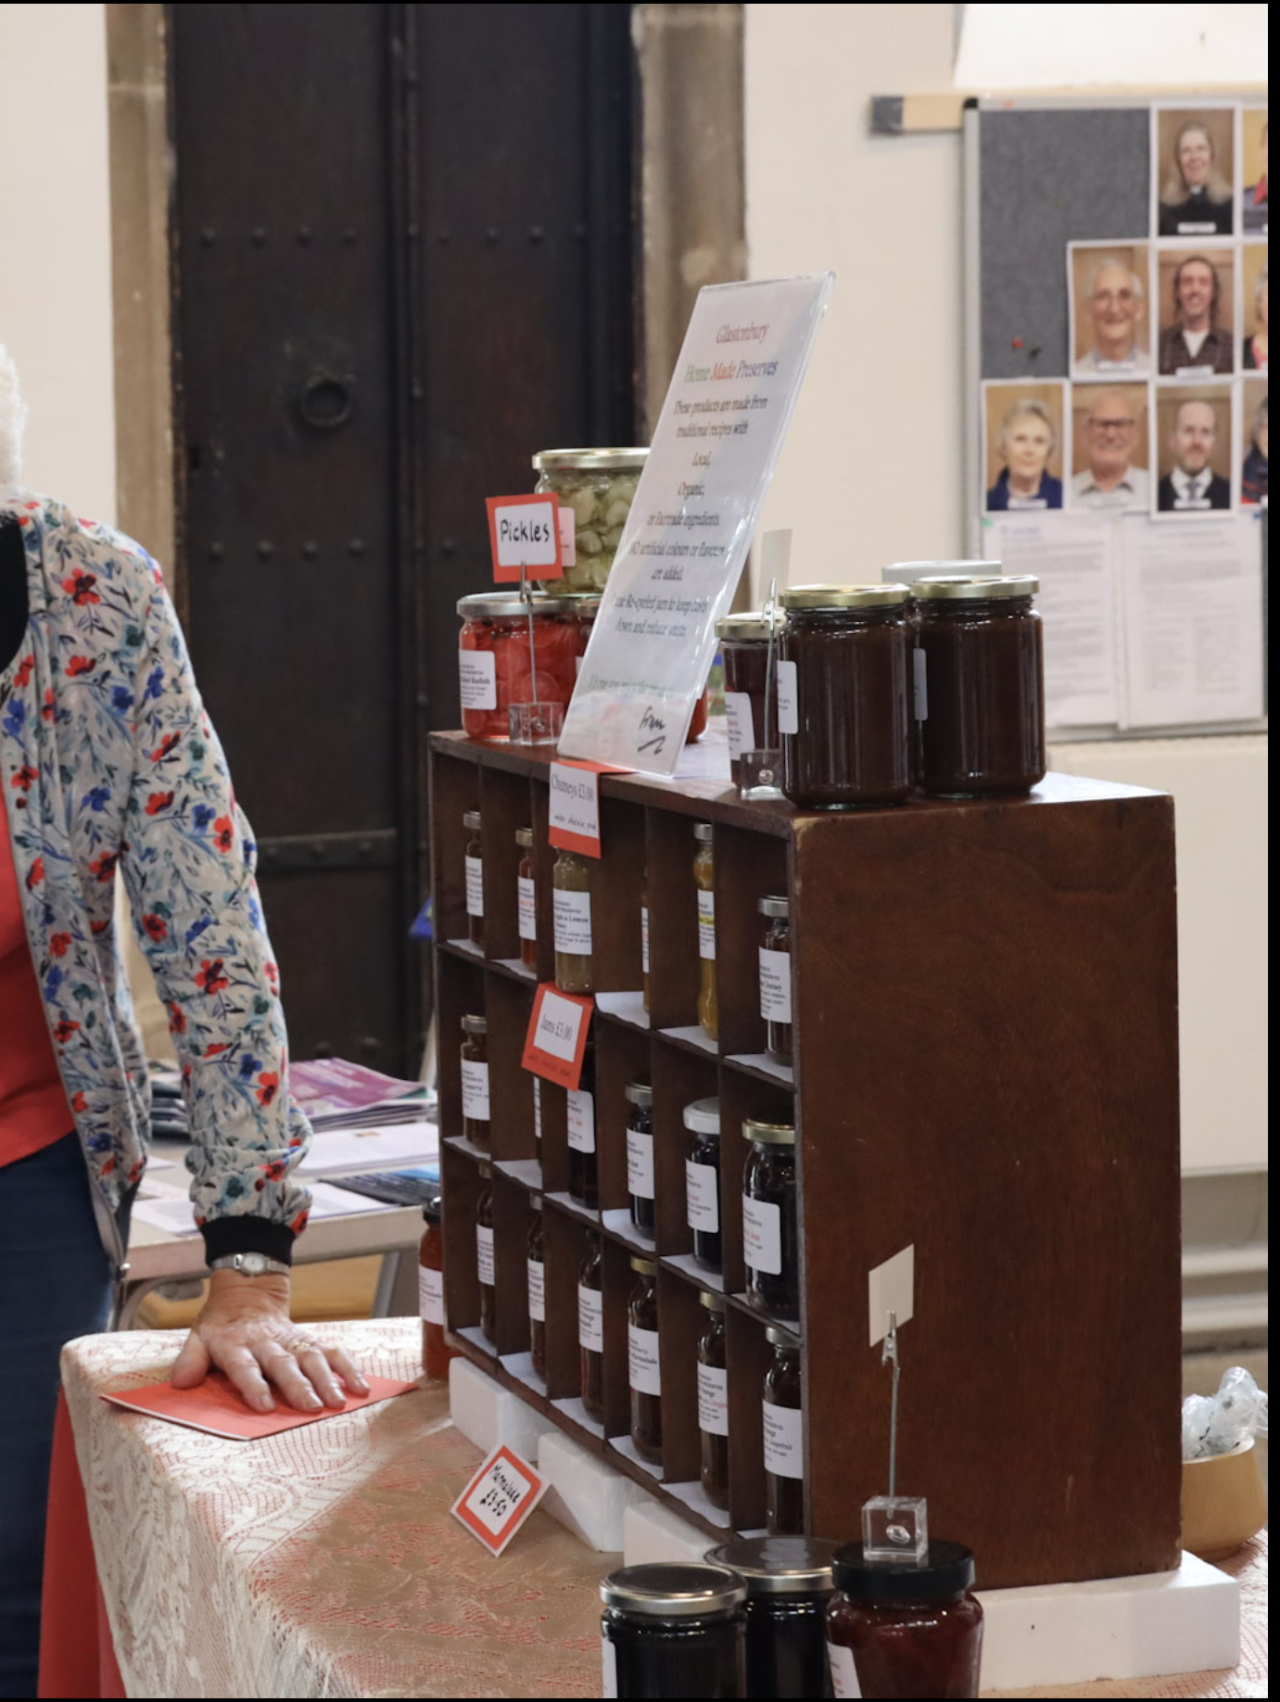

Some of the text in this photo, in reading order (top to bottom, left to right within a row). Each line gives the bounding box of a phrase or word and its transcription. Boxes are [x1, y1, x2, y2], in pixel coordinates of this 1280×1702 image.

[716, 322, 771, 344] Glastonbury
[685, 360, 778, 382] Home Made Preserves
[690, 399, 720, 417] products
[720, 401, 731, 411] are
[731, 396, 749, 410] made
[749, 394, 768, 409] from
[676, 420, 749, 438] traditional recipes with
[500, 518, 550, 543] Pickles
